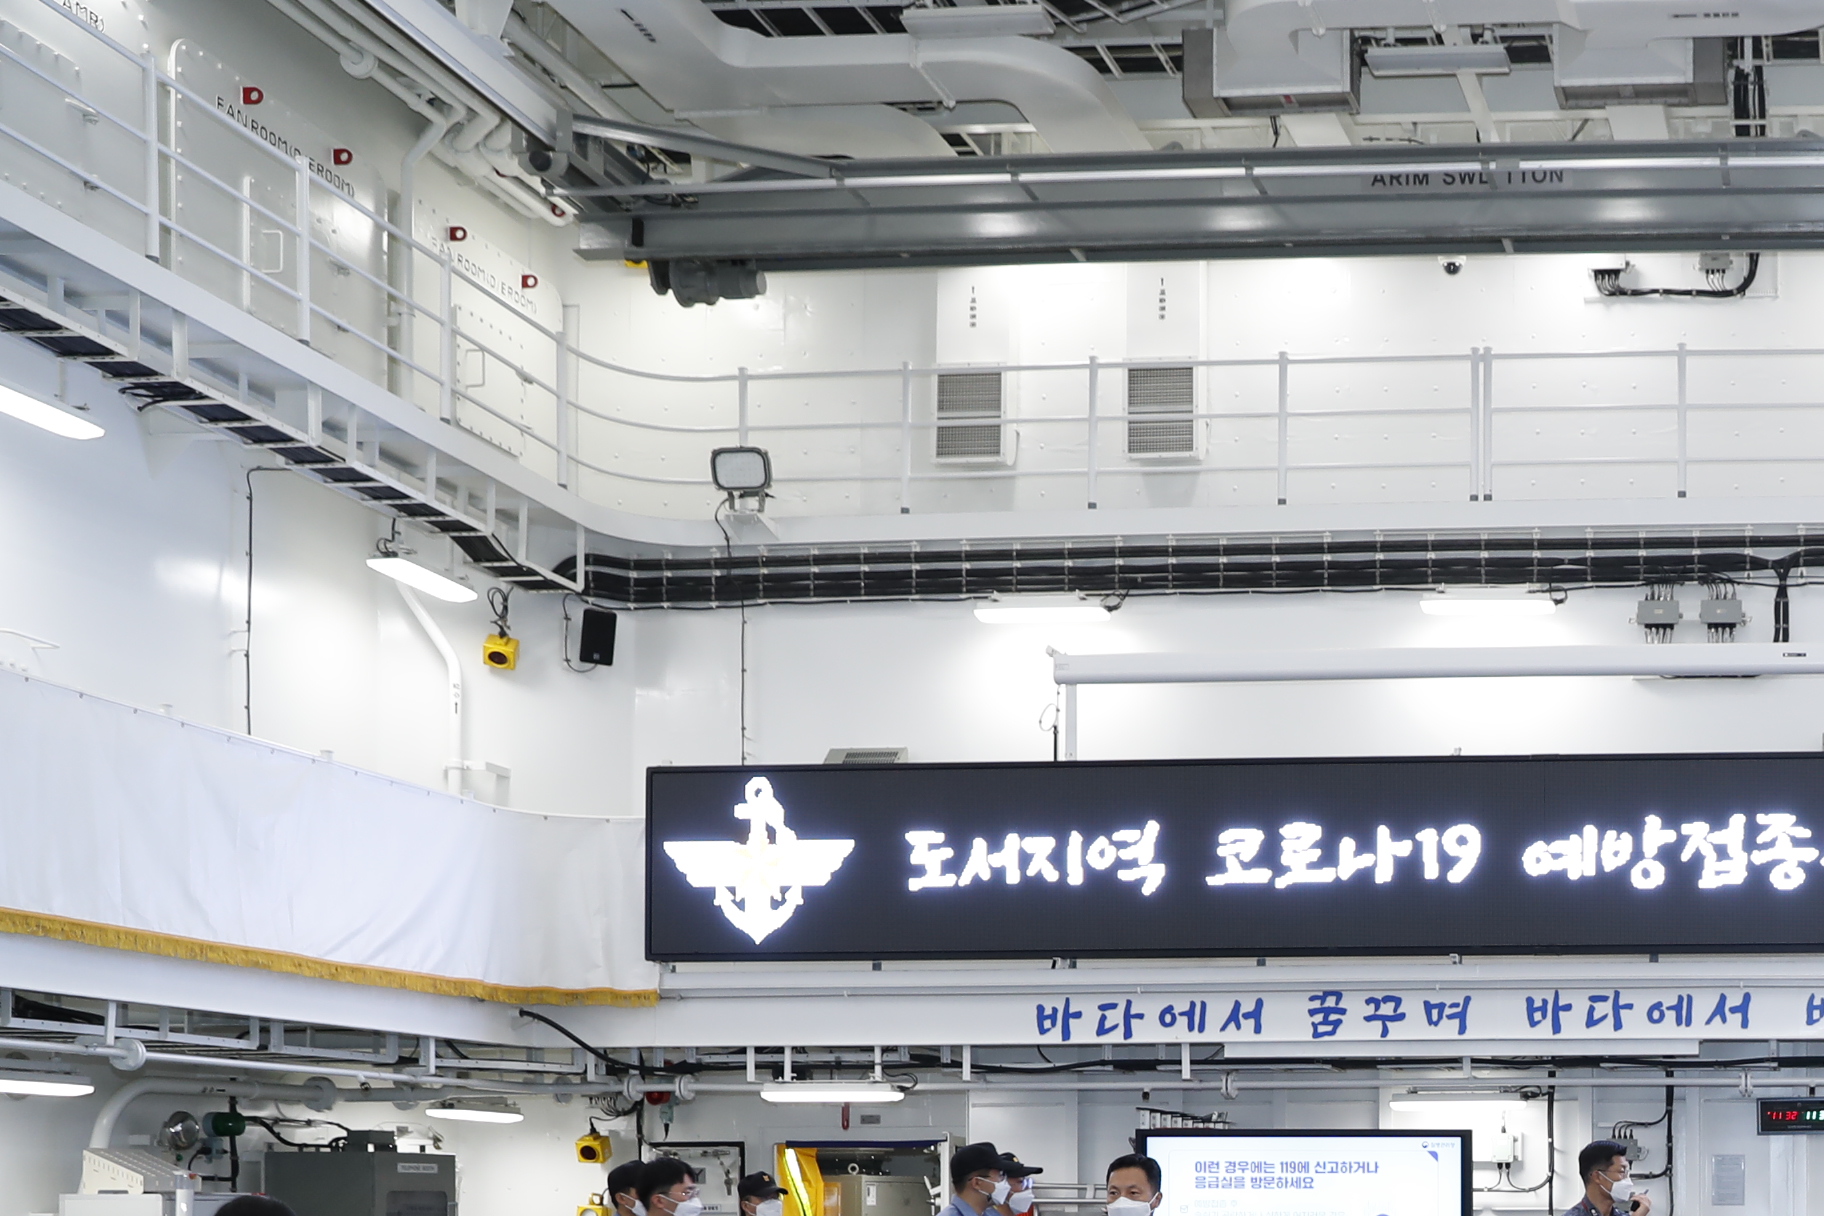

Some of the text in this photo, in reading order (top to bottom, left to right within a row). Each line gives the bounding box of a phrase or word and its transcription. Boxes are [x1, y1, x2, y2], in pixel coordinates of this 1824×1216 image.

[216, 96, 248, 128] FAN
[903, 820, 1167, 896] 도서지역
[1205, 821, 1482, 889] 코로나19
[1037, 997, 1265, 1043] 바다에서
[1308, 990, 1473, 1039] 꿈꾸며
[1525, 990, 1753, 1035] 바다에서
[1194, 1160, 1380, 1174] 이런 경우에는 119에 신고하거나
[1194, 1176, 1315, 1189] 응급실을 방문하세요
